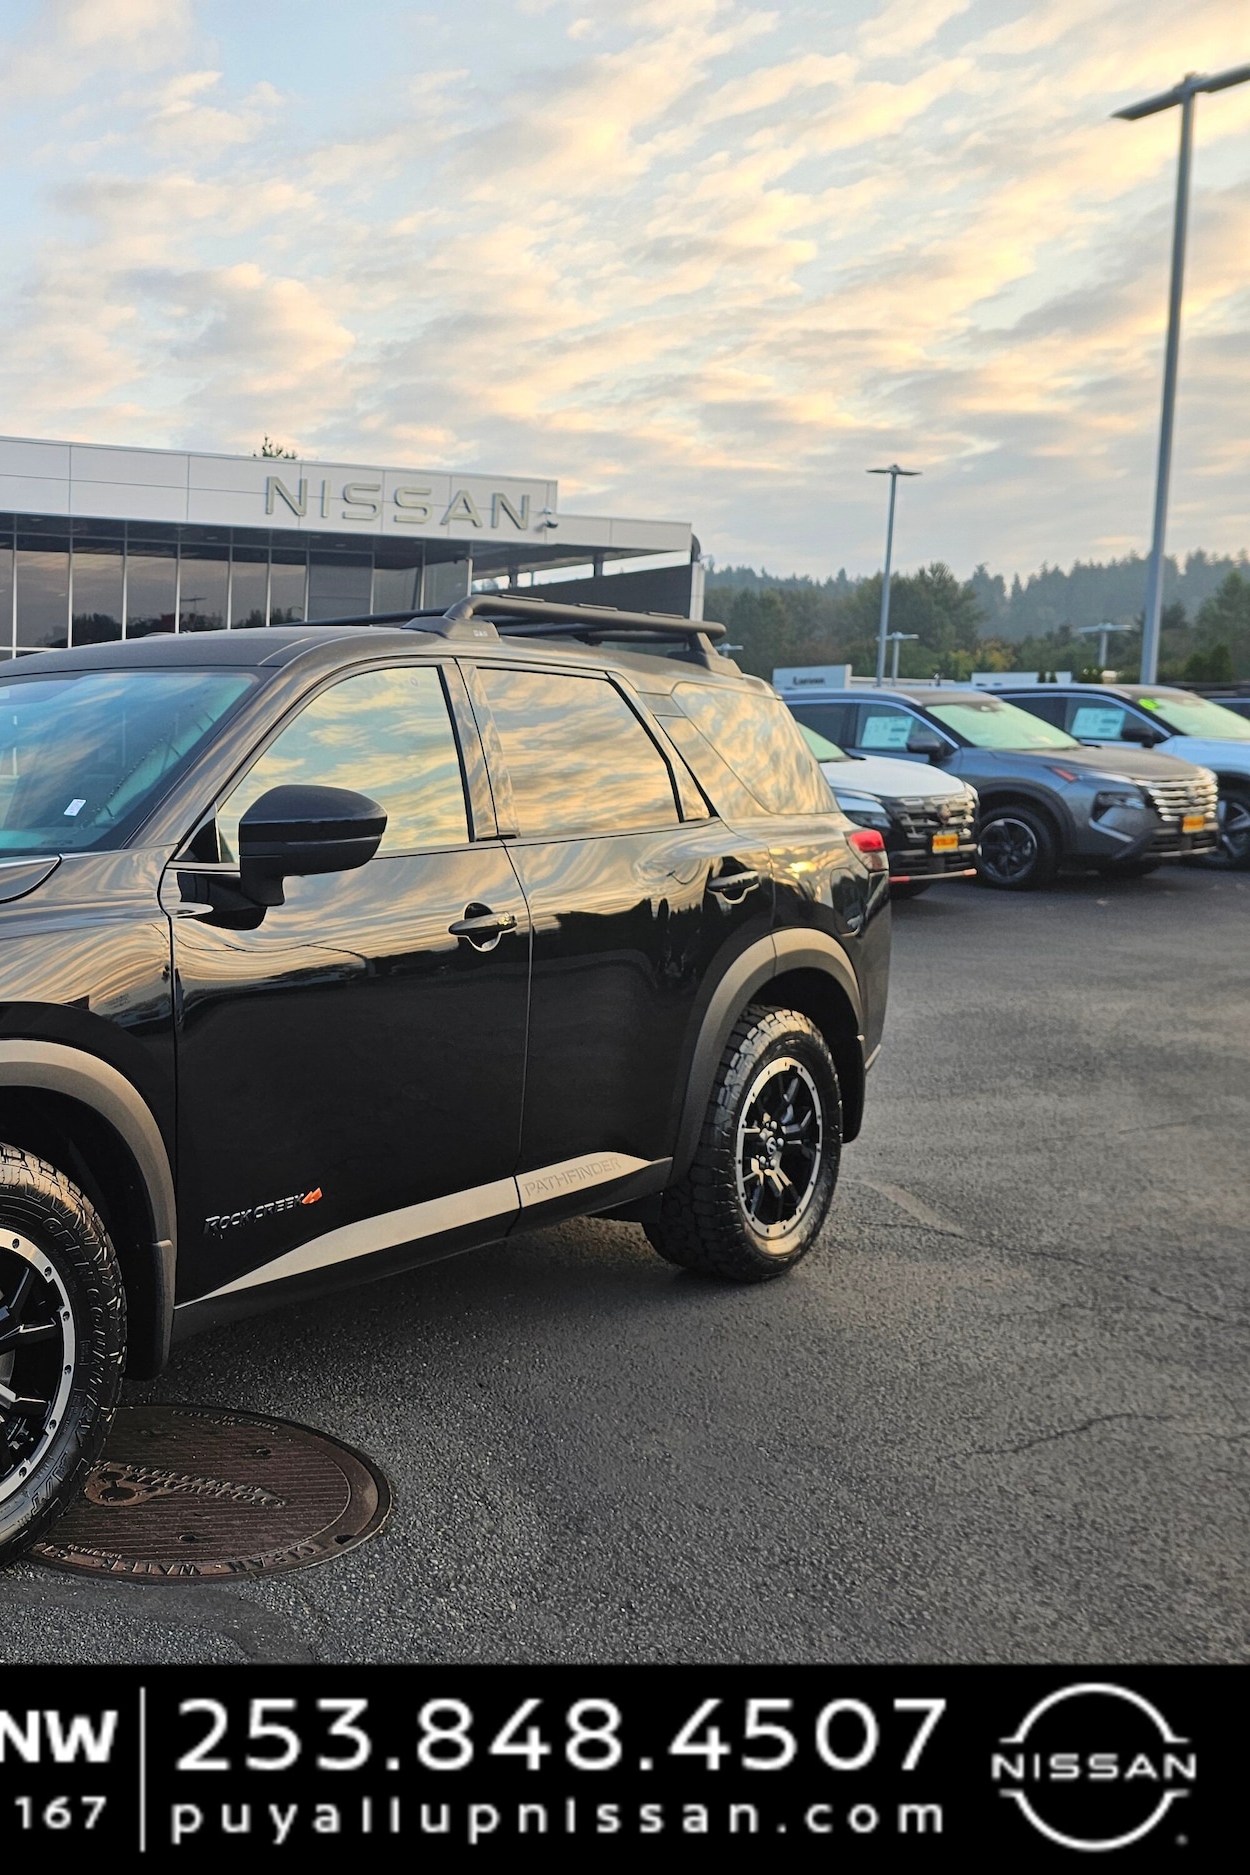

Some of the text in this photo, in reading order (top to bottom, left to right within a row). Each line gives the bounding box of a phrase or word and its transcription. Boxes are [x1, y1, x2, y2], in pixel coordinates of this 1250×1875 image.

[265, 476, 530, 530] NISSAN
[522, 1157, 622, 1197] PATHFINDER
[203, 1192, 305, 1235] ROCK CREEK
